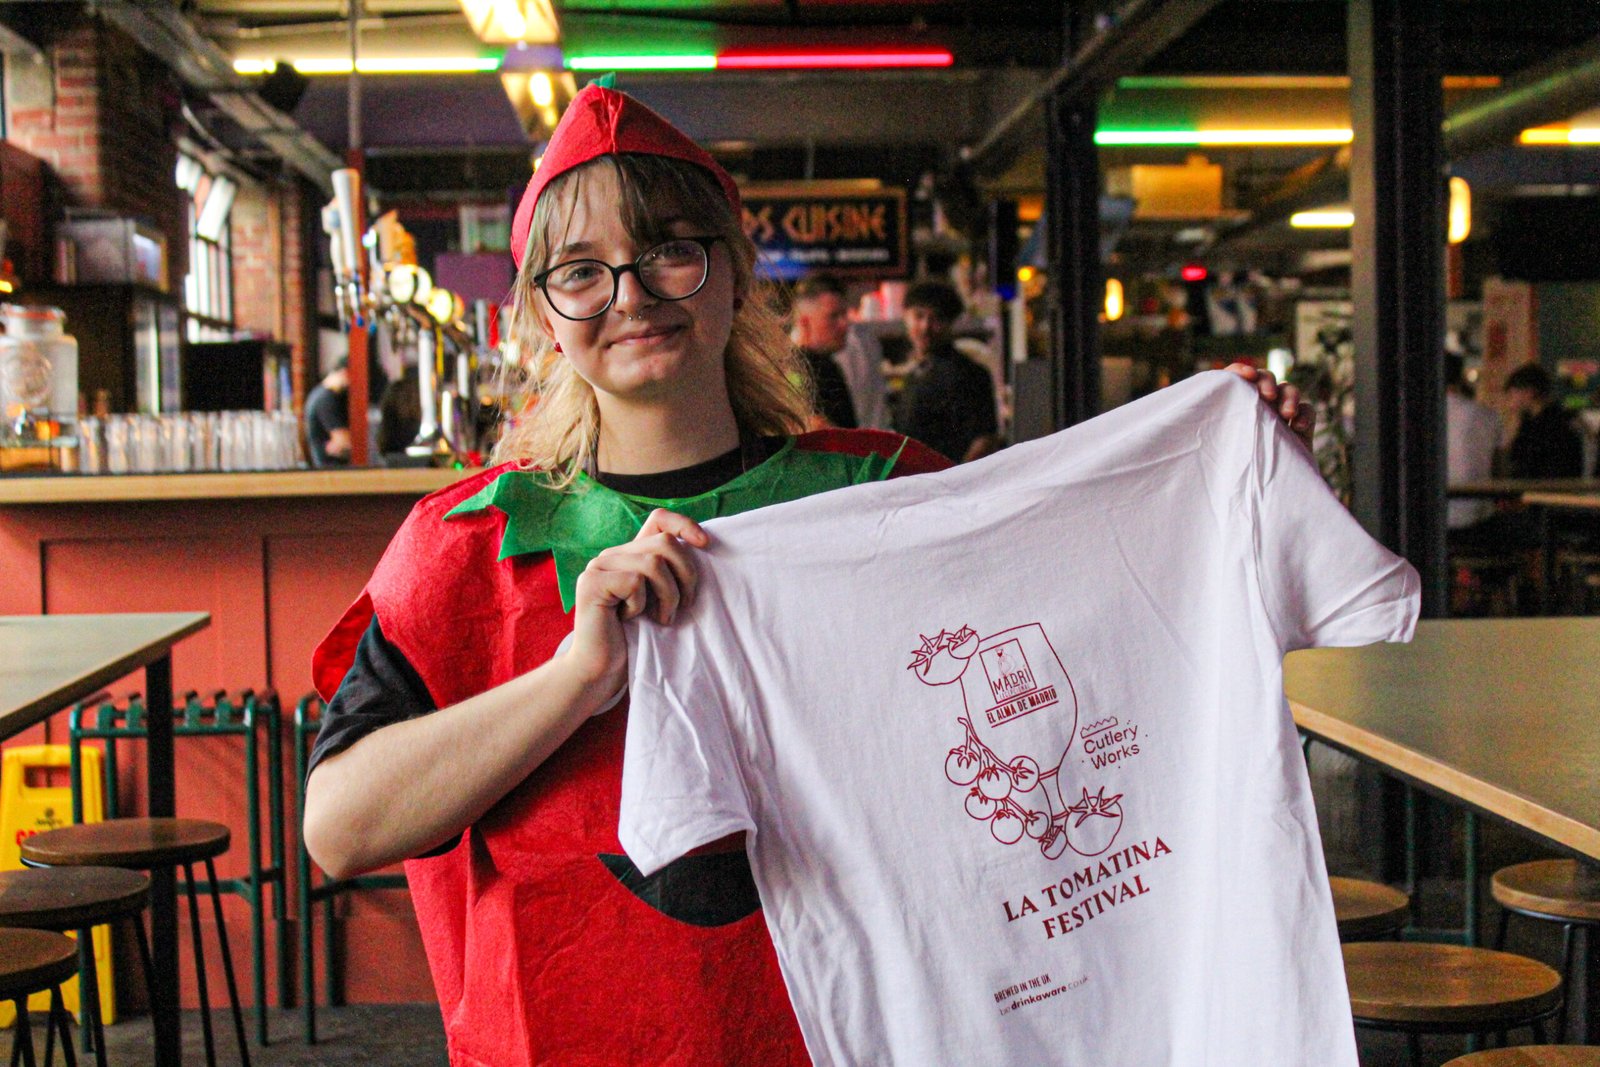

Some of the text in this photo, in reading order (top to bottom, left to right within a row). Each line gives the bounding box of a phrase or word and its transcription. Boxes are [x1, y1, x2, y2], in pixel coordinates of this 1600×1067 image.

[986, 688, 1058, 724] EL ALMA DE MADRID
[1084, 724, 1138, 754] Cutlery
[1091, 743, 1140, 770] Works
[1002, 836, 1173, 923] LA TOMATINA
[1041, 874, 1151, 940] FESTIVAL
[994, 973, 1052, 1003] BREWED IN THE UK
